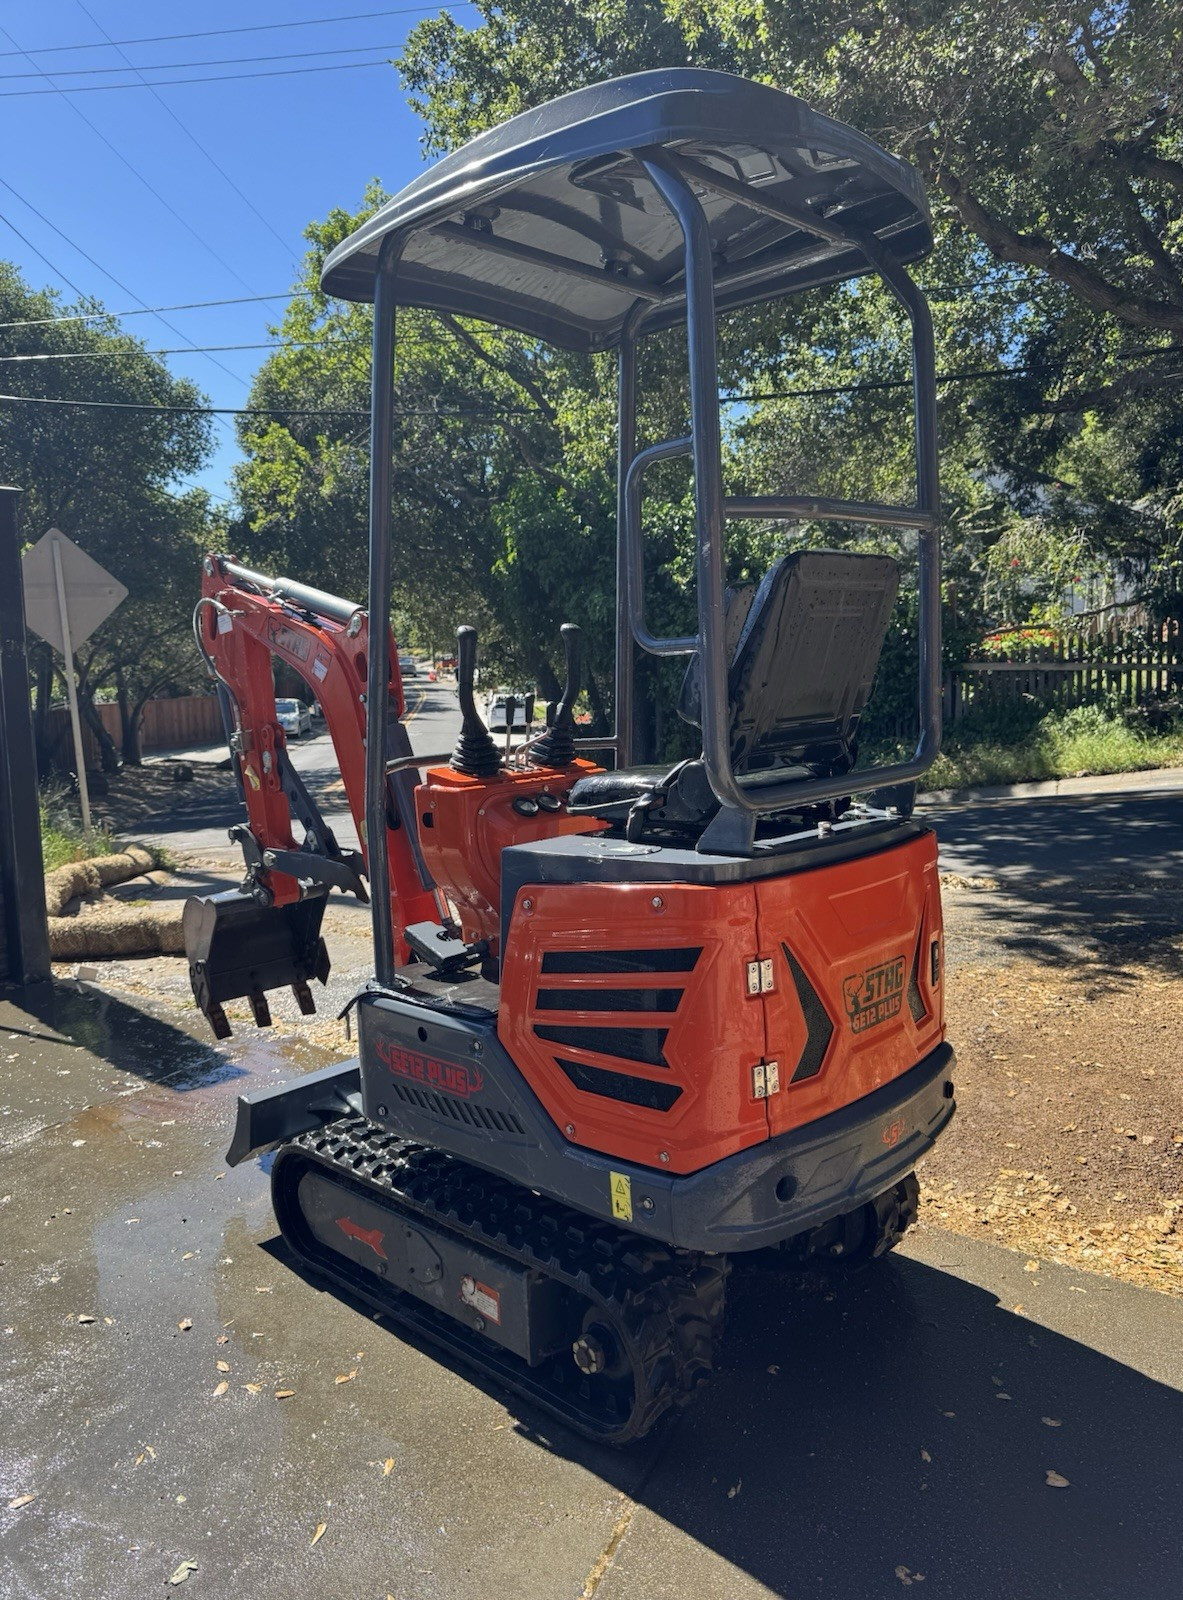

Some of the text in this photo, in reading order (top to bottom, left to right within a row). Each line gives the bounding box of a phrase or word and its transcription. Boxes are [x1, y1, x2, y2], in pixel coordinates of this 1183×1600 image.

[863, 961, 903, 1003] STHG
[878, 995, 901, 1019] PLUS
[427, 1060, 466, 1093] PLUS
